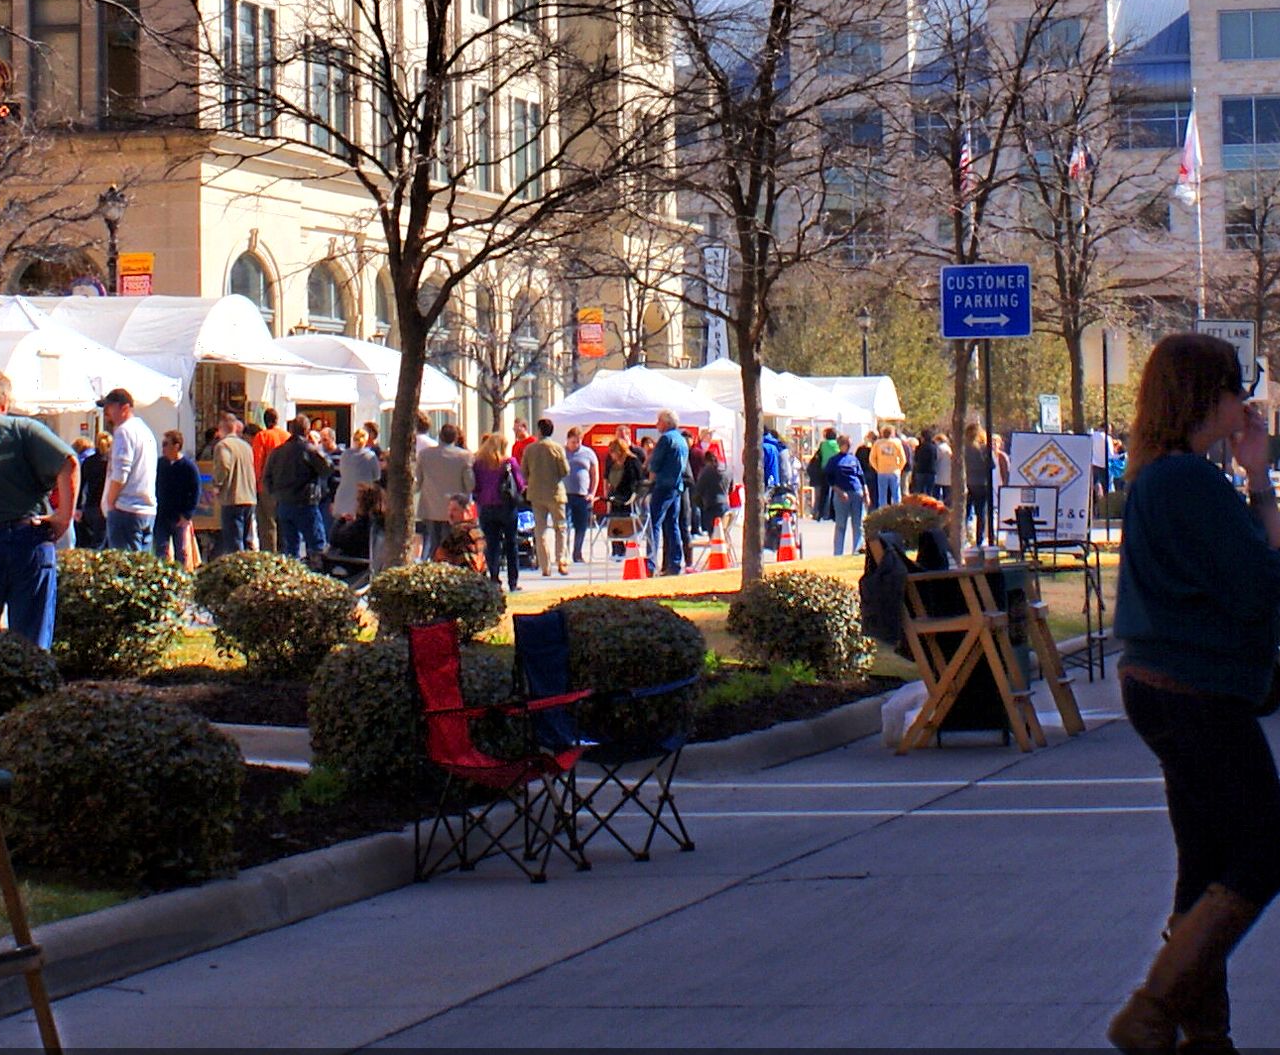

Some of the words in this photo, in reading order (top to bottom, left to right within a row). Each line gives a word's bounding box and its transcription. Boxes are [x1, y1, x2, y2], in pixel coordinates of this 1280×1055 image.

[946, 274, 1025, 291] CUSTOMER
[954, 293, 1019, 309] PARKING
[1228, 328, 1250, 339] LANE
